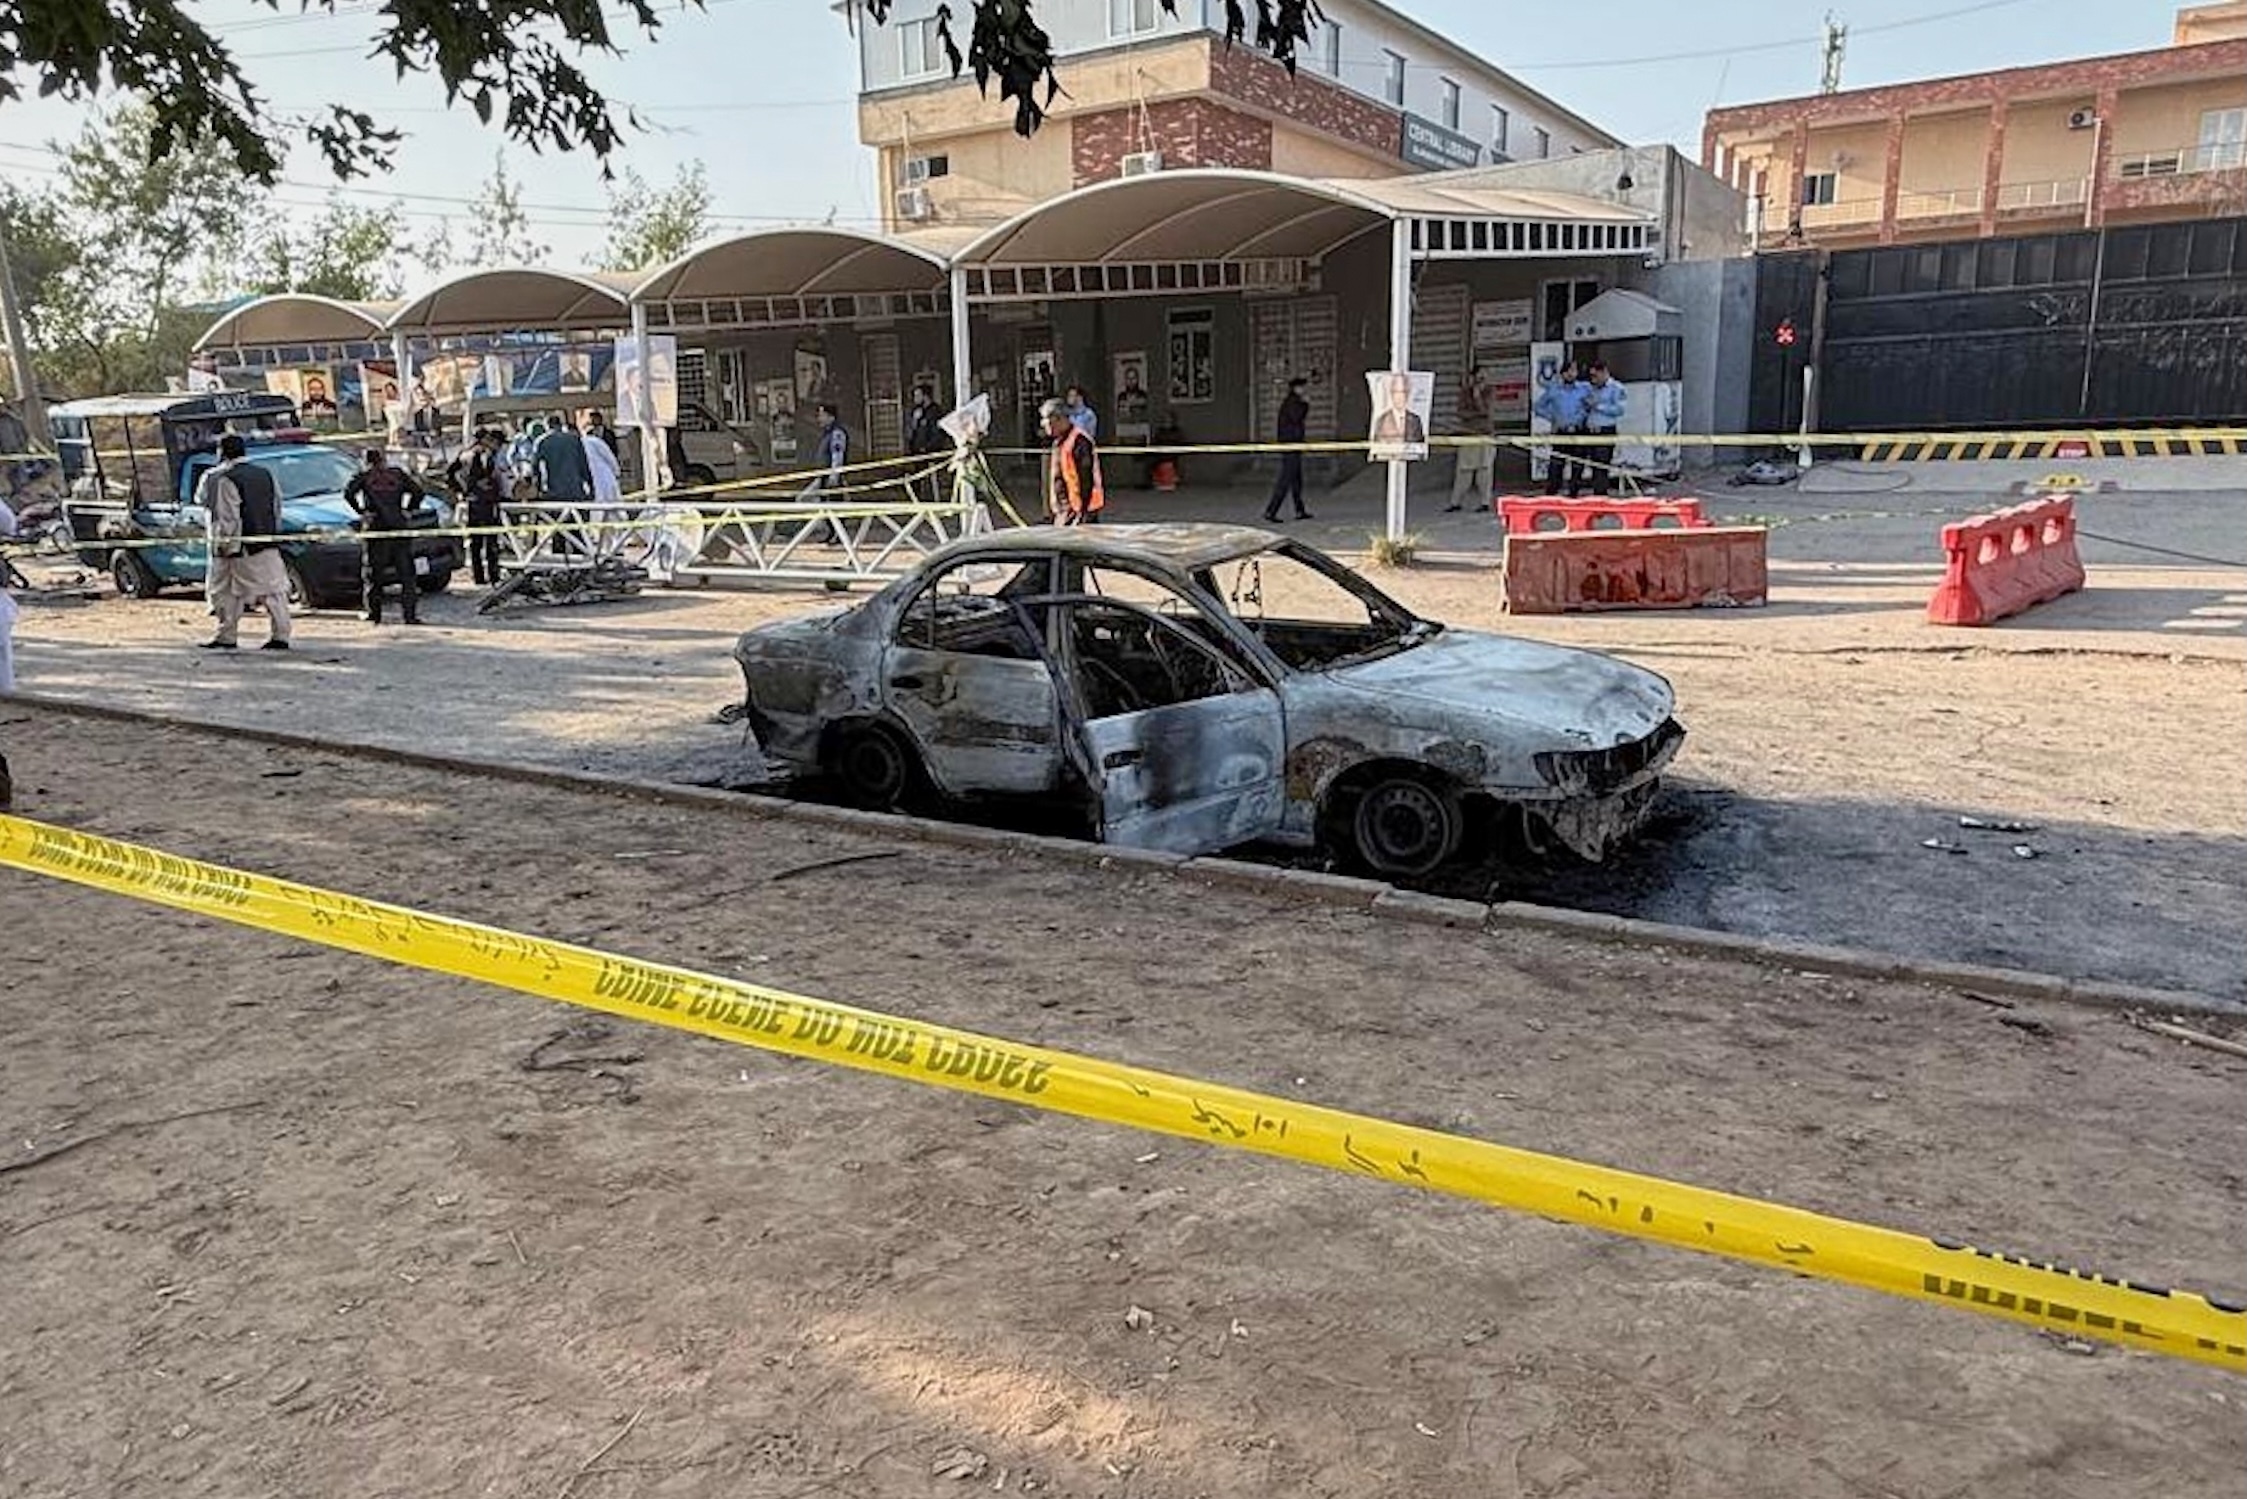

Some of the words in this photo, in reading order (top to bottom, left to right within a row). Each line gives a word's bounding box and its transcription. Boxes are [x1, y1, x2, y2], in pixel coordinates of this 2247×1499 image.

[1408, 123, 1443, 152] CENTRAL
[1445, 139, 1476, 166] LIBRARY
[213, 393, 251, 412] POLICE
[2057, 448, 2087, 459] STOP
